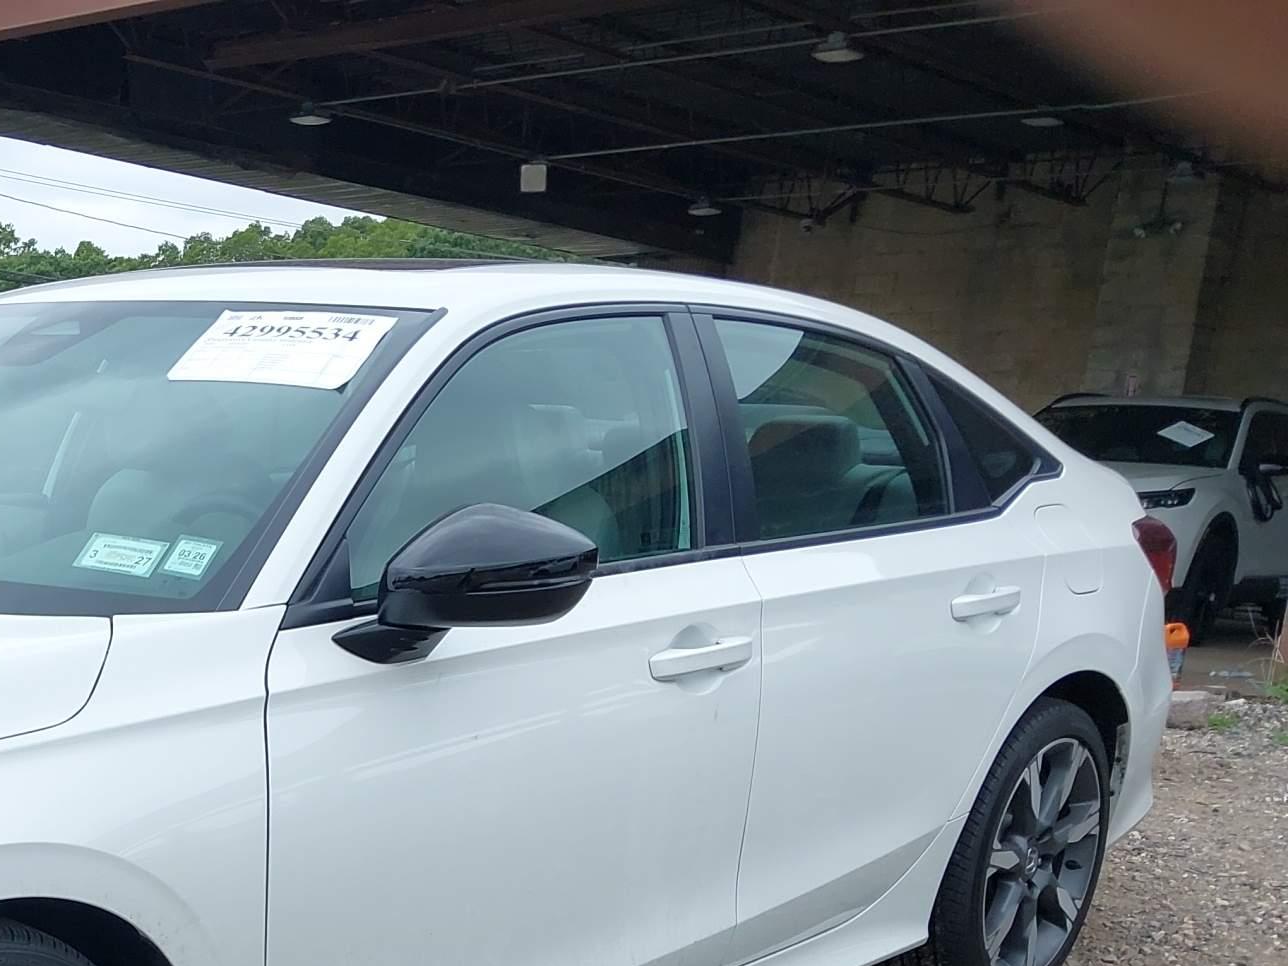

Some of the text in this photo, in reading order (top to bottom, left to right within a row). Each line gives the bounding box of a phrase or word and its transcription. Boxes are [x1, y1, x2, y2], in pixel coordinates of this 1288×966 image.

[223, 324, 362, 342] 42995534
[89, 549, 99, 559] 3
[134, 555, 153, 567] 27
